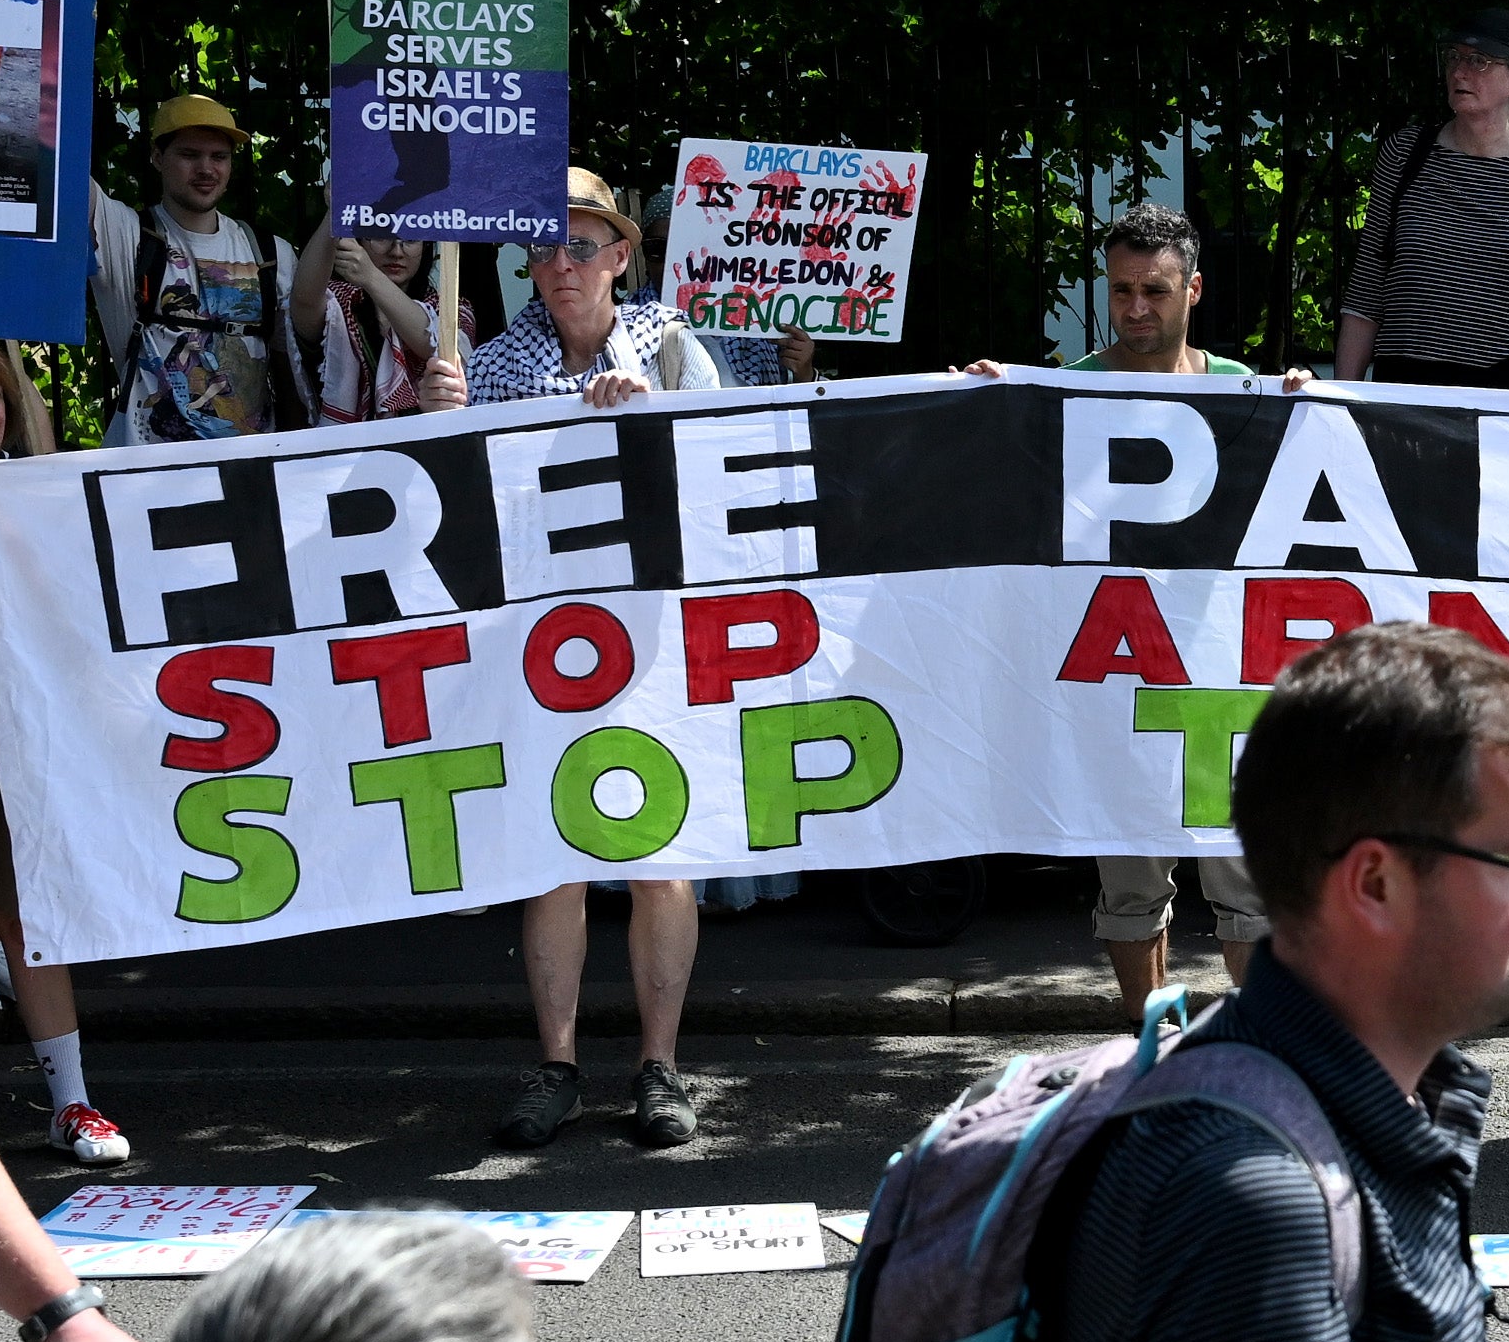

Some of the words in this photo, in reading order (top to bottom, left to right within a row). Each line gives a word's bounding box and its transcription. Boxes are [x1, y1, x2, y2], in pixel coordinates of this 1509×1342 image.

[363, 0, 535, 33] BARCLAYS
[385, 34, 513, 66] SERVES
[376, 68, 522, 101] ISRAEL'S
[361, 102, 536, 136] GENOCIDE
[744, 145, 863, 178] BARCLAYS
[696, 182, 735, 208] IS
[747, 183, 806, 210] THE
[341, 205, 559, 238] #BoycottBarclays
[723, 220, 852, 251] SPONSOR
[856, 226, 892, 252] OF
[686, 255, 856, 287] WIMBLEDON
[867, 264, 895, 290] &
[691, 292, 894, 337] GENOCIDE
[97, 408, 820, 647] FREE
[155, 588, 821, 774] STOP
[173, 694, 903, 924] STOP
[72, 1193, 281, 1217] Double
[654, 1207, 746, 1220] KEEP
[655, 1243, 697, 1253] OF
[712, 1236, 811, 1250] SPORT
[686, 1228, 748, 1240] OUT
